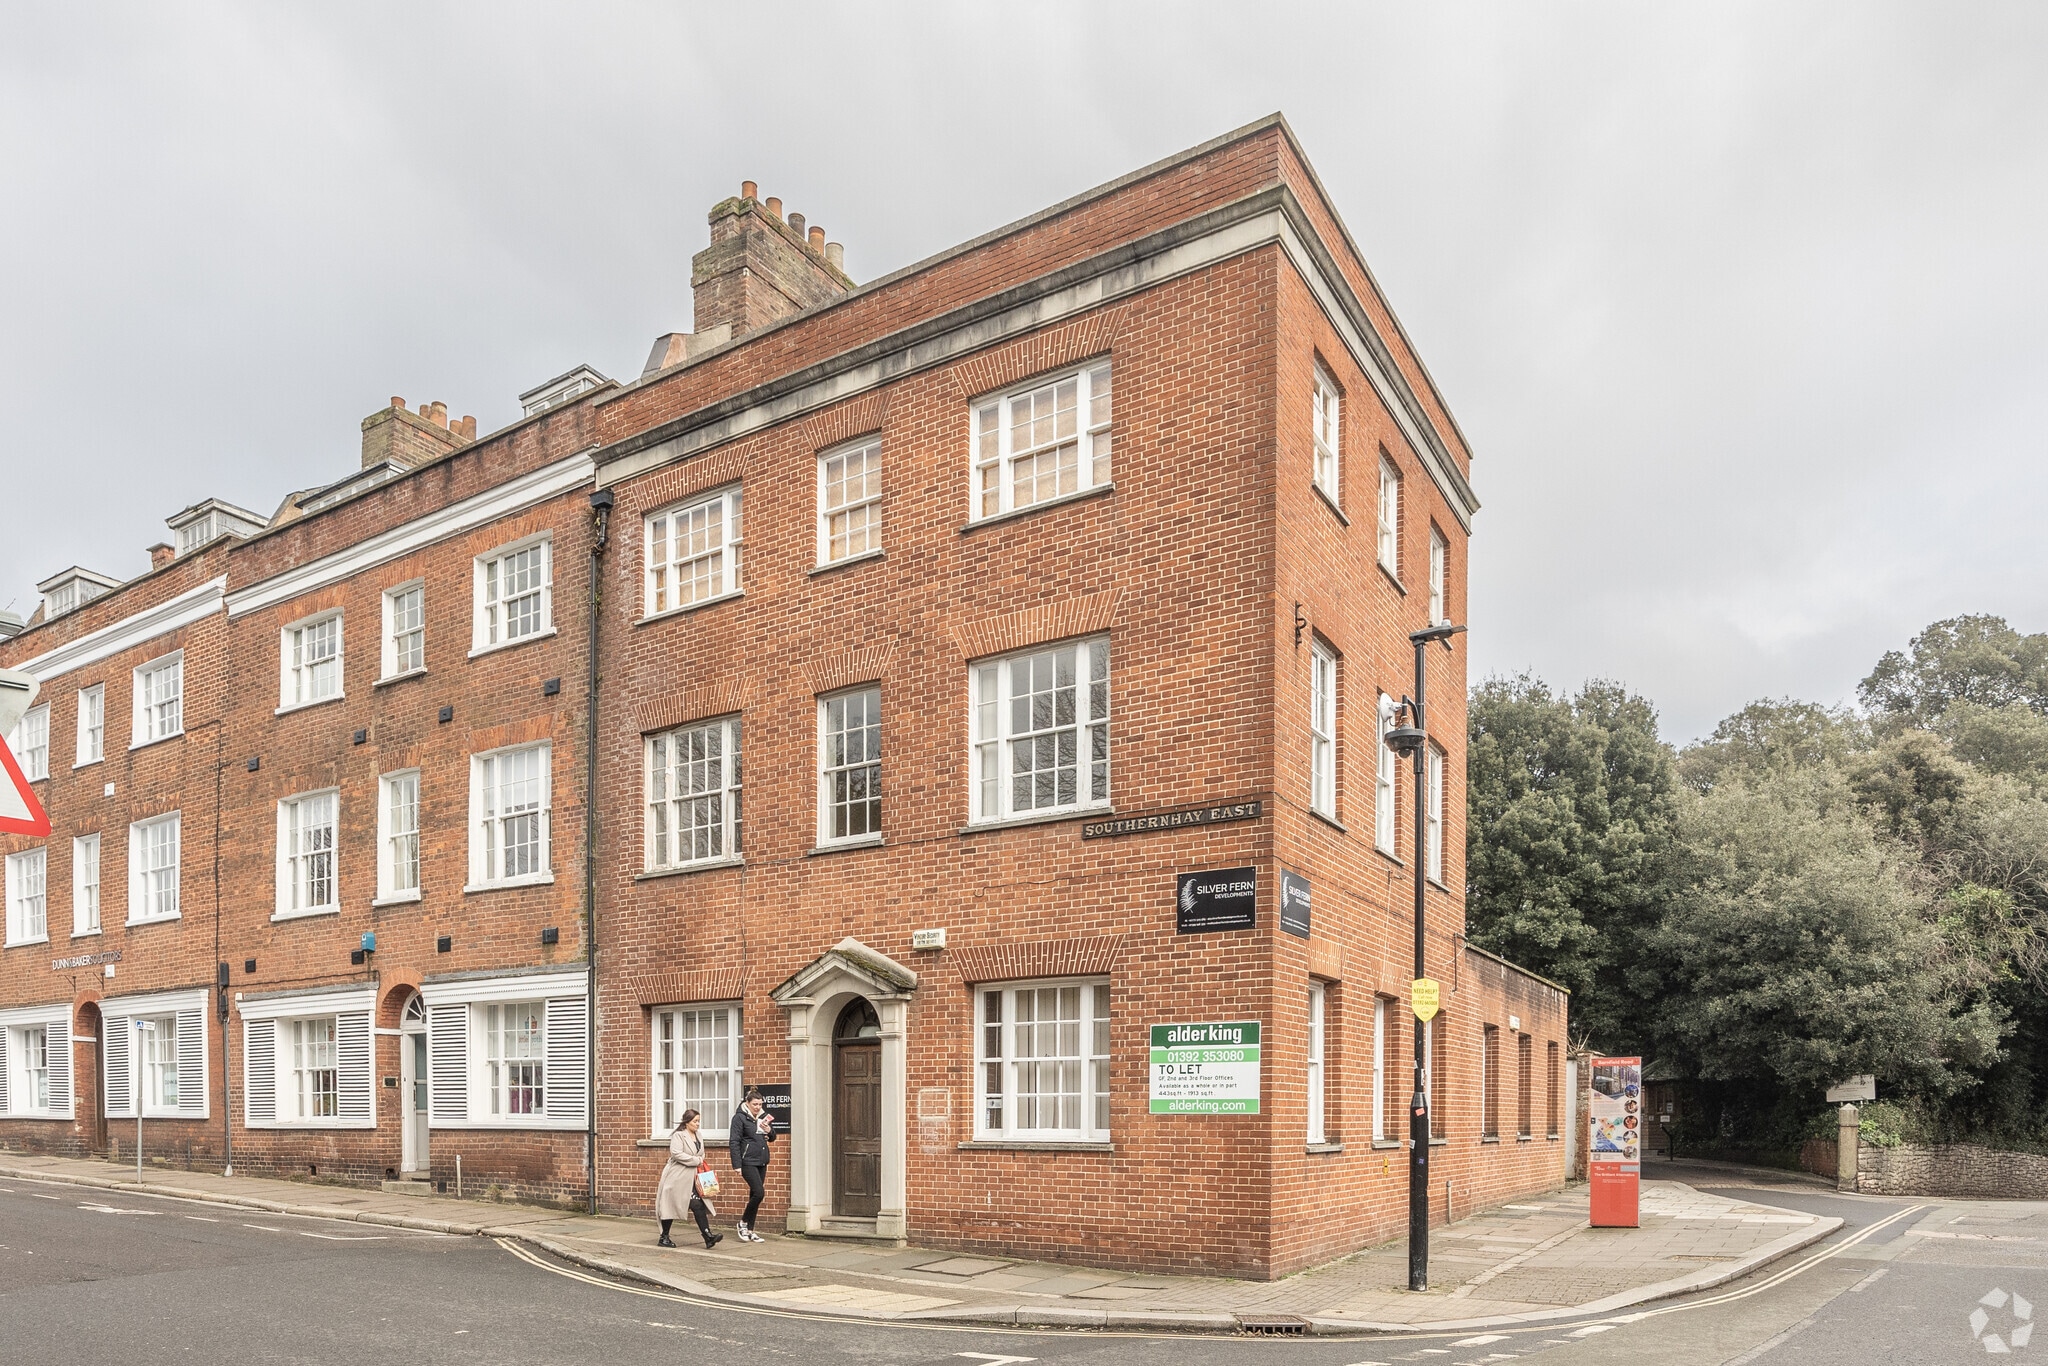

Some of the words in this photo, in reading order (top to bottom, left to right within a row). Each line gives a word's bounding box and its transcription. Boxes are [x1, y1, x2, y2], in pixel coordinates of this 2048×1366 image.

[1085, 811, 1203, 836] SOUTHERNHAY
[1209, 803, 1257, 820] EAST
[1197, 884, 1228, 895] SILVER
[1229, 881, 1254, 891] FERN
[1214, 890, 1254, 900] DEVELOPMENTS
[1167, 1026, 1207, 1042] alder
[1208, 1025, 1243, 1044] king
[1167, 1052, 1200, 1063] 01392
[1202, 1050, 1245, 1062] 353080
[1159, 1064, 1175, 1075] TO
[1179, 1064, 1203, 1075] LET
[1169, 1100, 1246, 1112] alderking.com
